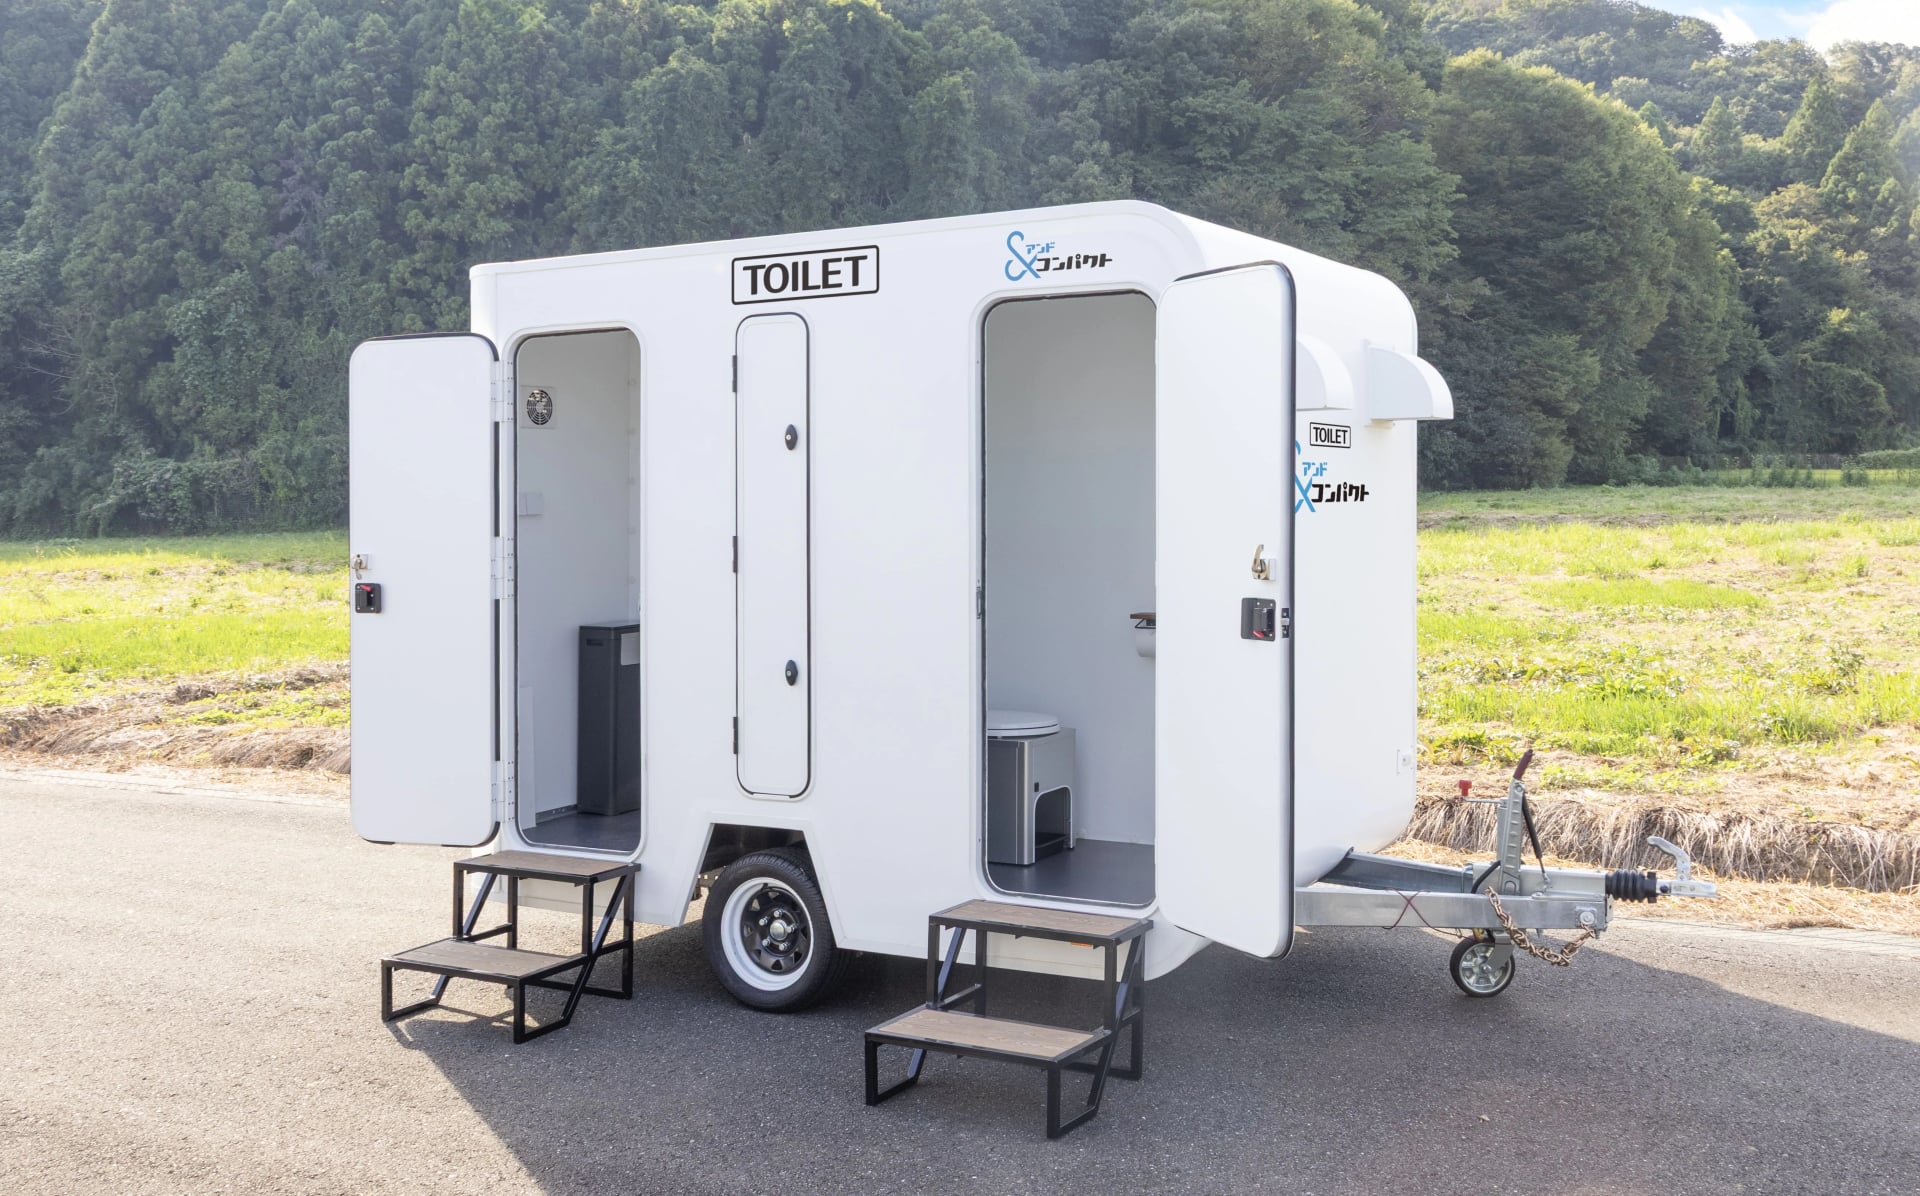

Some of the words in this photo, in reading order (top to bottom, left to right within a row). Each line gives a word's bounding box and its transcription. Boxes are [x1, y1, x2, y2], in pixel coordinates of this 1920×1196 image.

[1025, 241, 1055, 255] アンド
[1036, 253, 1113, 272] コンパクト
[743, 255, 868, 295] TOILET
[1313, 426, 1348, 444] TOILET
[1302, 461, 1328, 477] アンド
[1311, 481, 1370, 503] コンパクト
